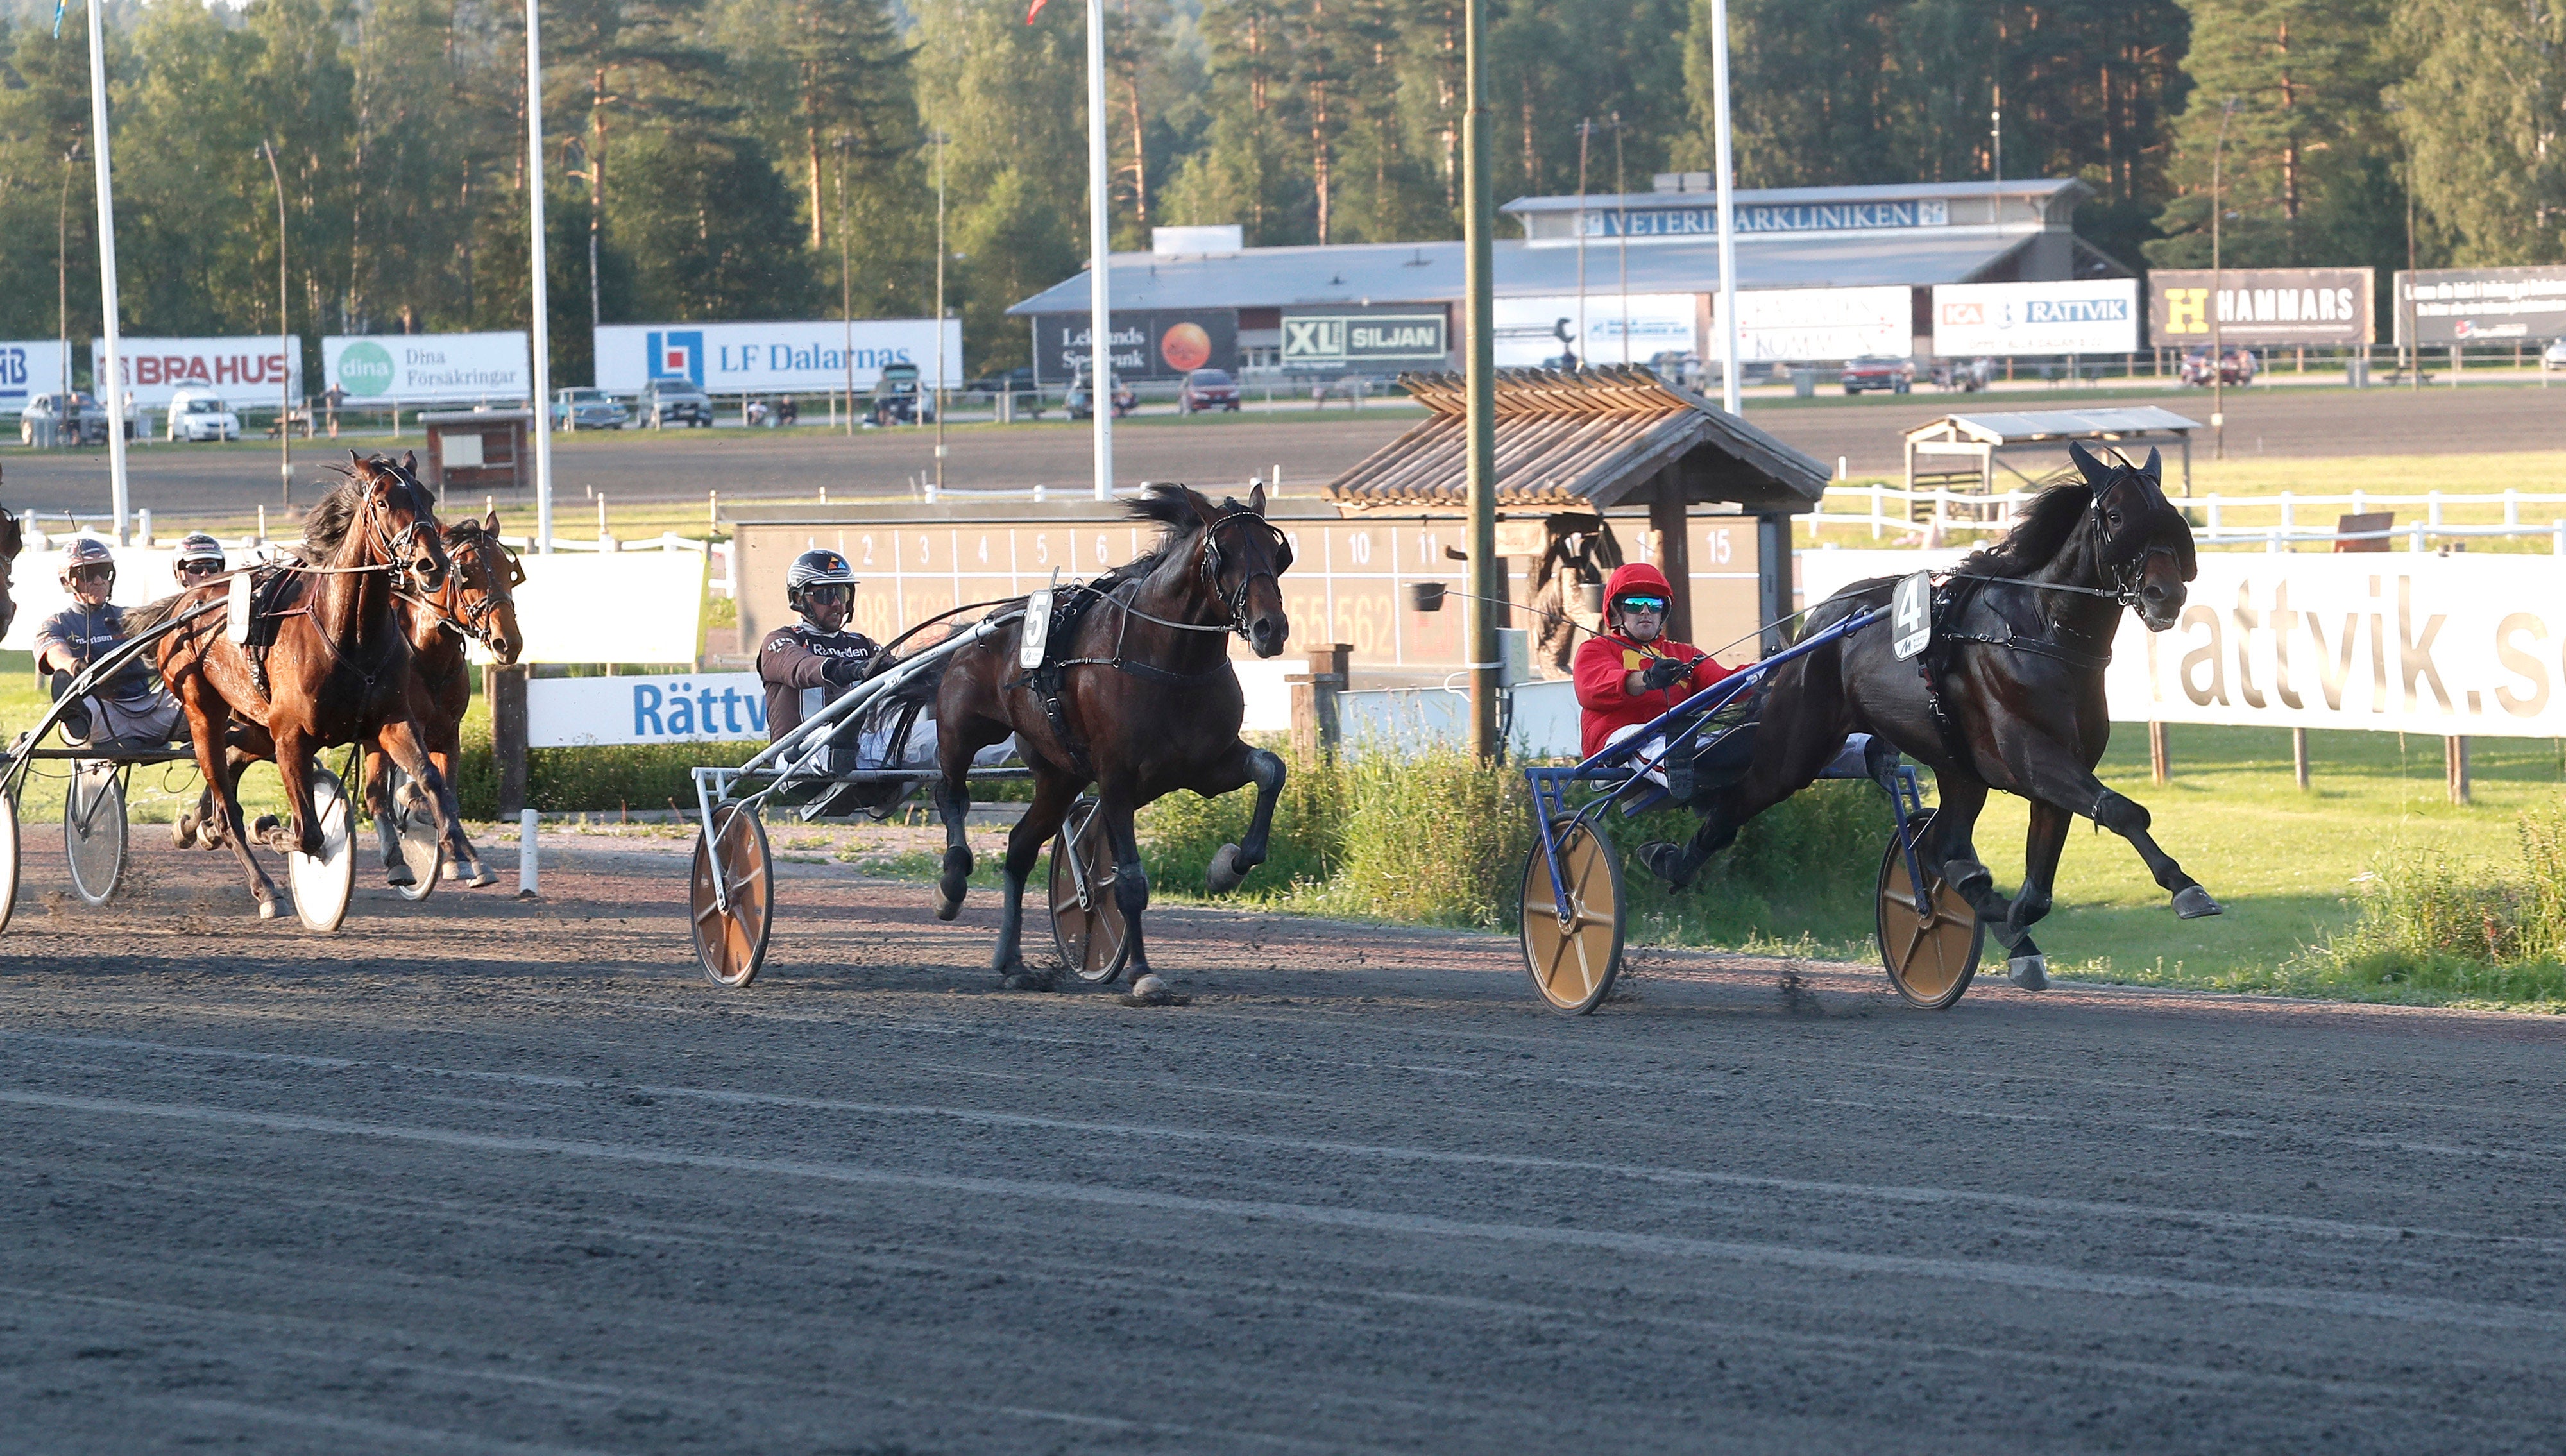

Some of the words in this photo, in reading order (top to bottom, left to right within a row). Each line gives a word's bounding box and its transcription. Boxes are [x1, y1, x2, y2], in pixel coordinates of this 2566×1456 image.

[1946, 305, 1982, 323] ICA
[2216, 288, 2353, 321] HAMMARS
[1287, 322, 1340, 355] XL
[1351, 326, 1435, 348] SILJAN
[137, 355, 290, 384] BRAHUS
[342, 358, 389, 376] dina
[406, 348, 446, 364] Dina
[720, 344, 759, 371] LF
[770, 342, 910, 371] Dalarnas
[407, 368, 516, 386] Försäkringar
[862, 534, 873, 566] 2
[919, 535, 930, 564] 3
[978, 535, 989, 564] 4
[1037, 533, 1048, 564] 5
[1095, 533, 1108, 564] 6
[1348, 531, 1370, 565] 10
[1418, 532, 1437, 564] 11
[1706, 529, 1732, 565] 15
[1898, 577, 1921, 633] 4
[1026, 594, 1049, 647] 5
[2148, 575, 2566, 718] rattvik.s
